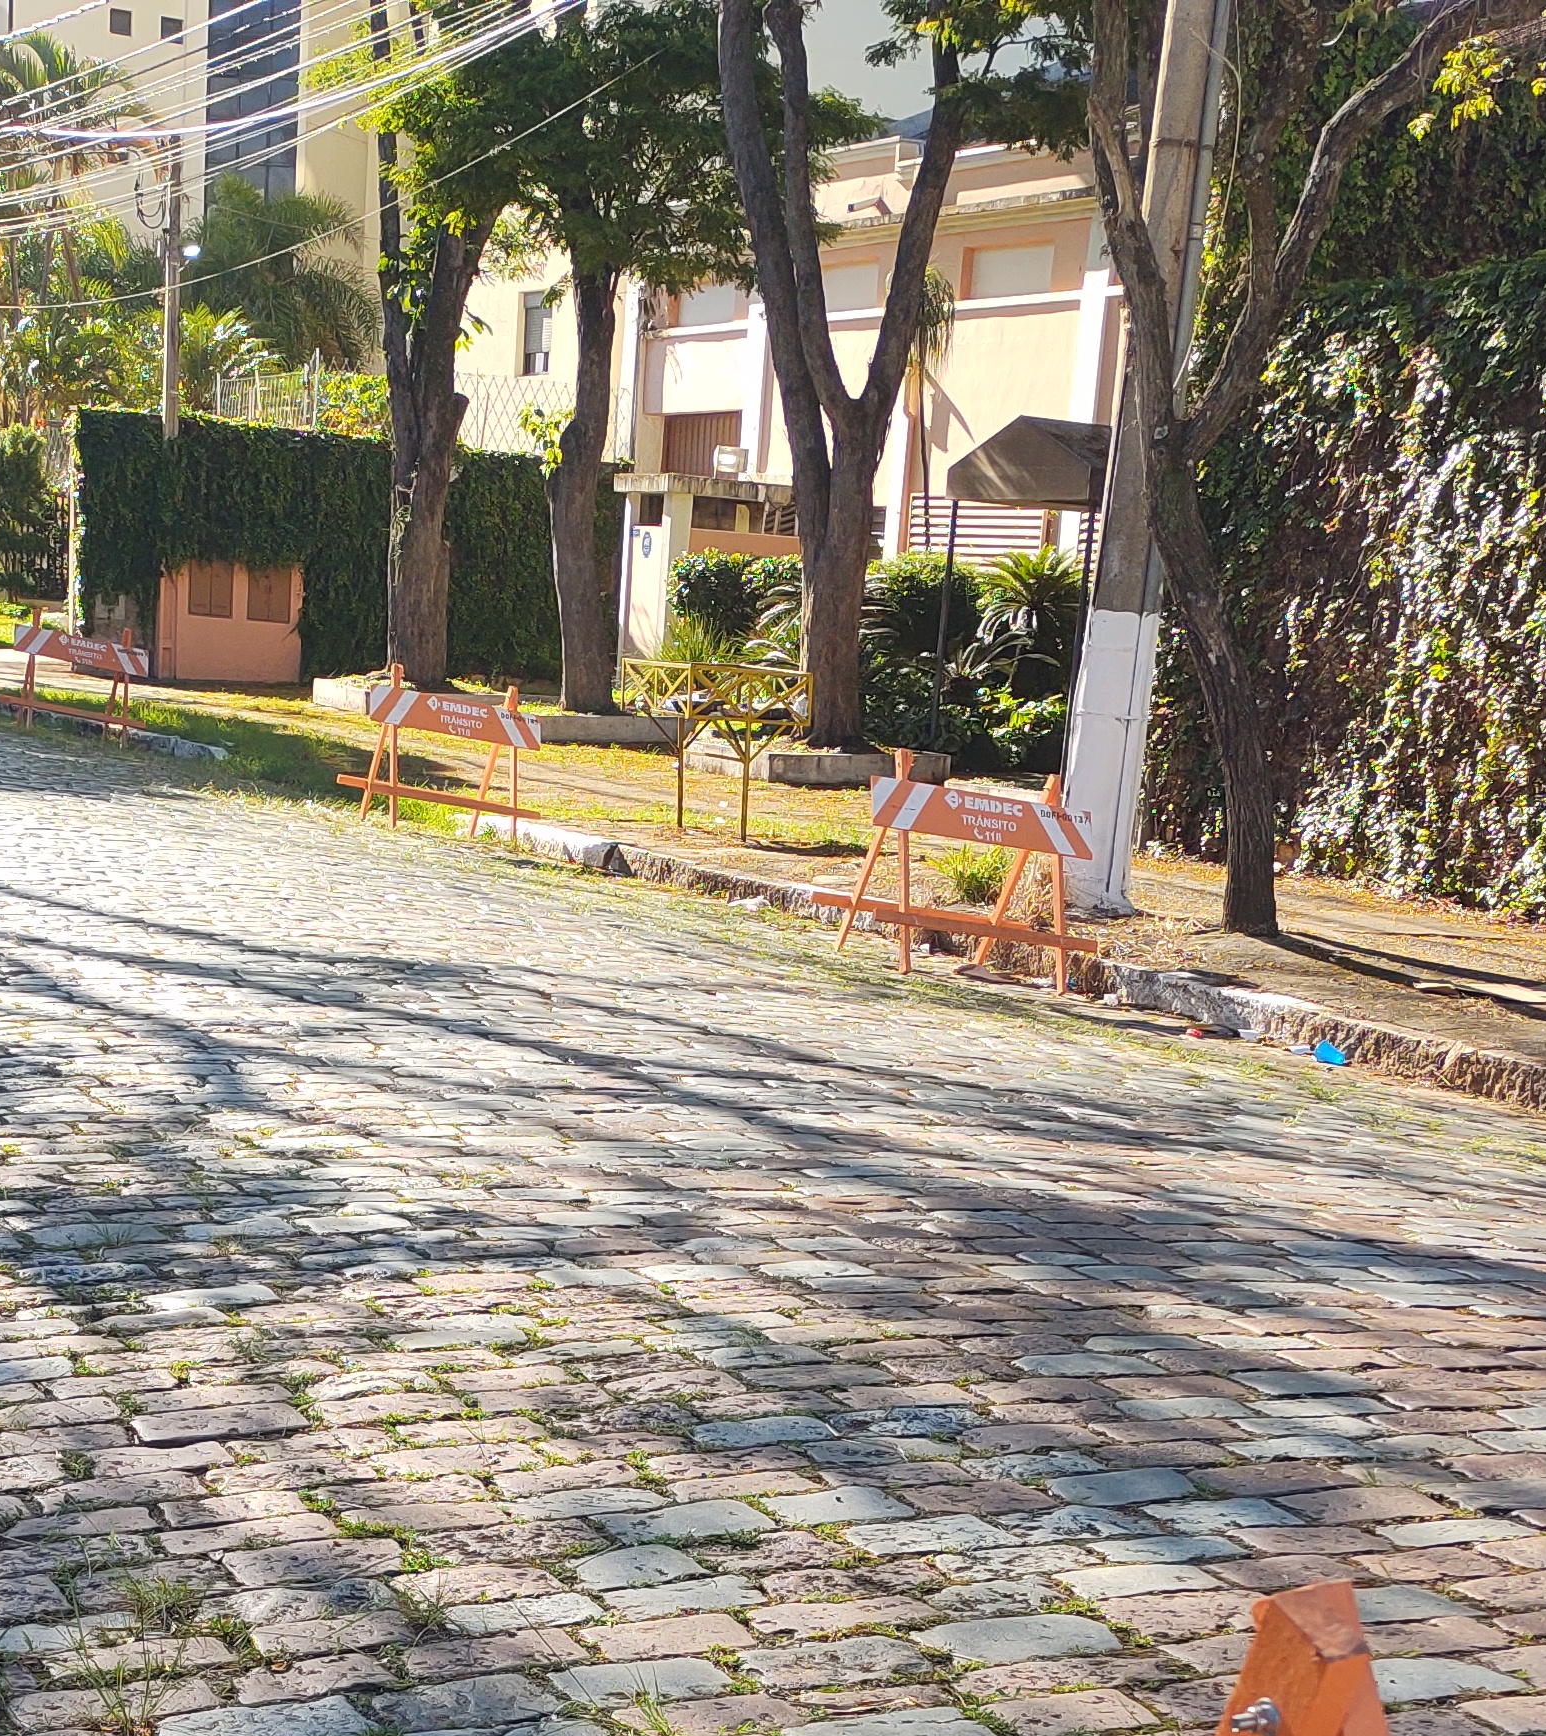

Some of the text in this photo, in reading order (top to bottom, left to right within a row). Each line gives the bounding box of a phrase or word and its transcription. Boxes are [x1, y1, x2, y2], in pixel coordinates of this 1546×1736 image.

[70, 637, 108, 652] EMDEC
[442, 702, 489, 719] EMDEC
[440, 714, 483, 729] TRÂNSITO
[457, 728, 471, 737] 118
[964, 796, 1023, 818] EMDEC
[961, 814, 1017, 832] TRÂNSITO
[984, 830, 1002, 843] 118
